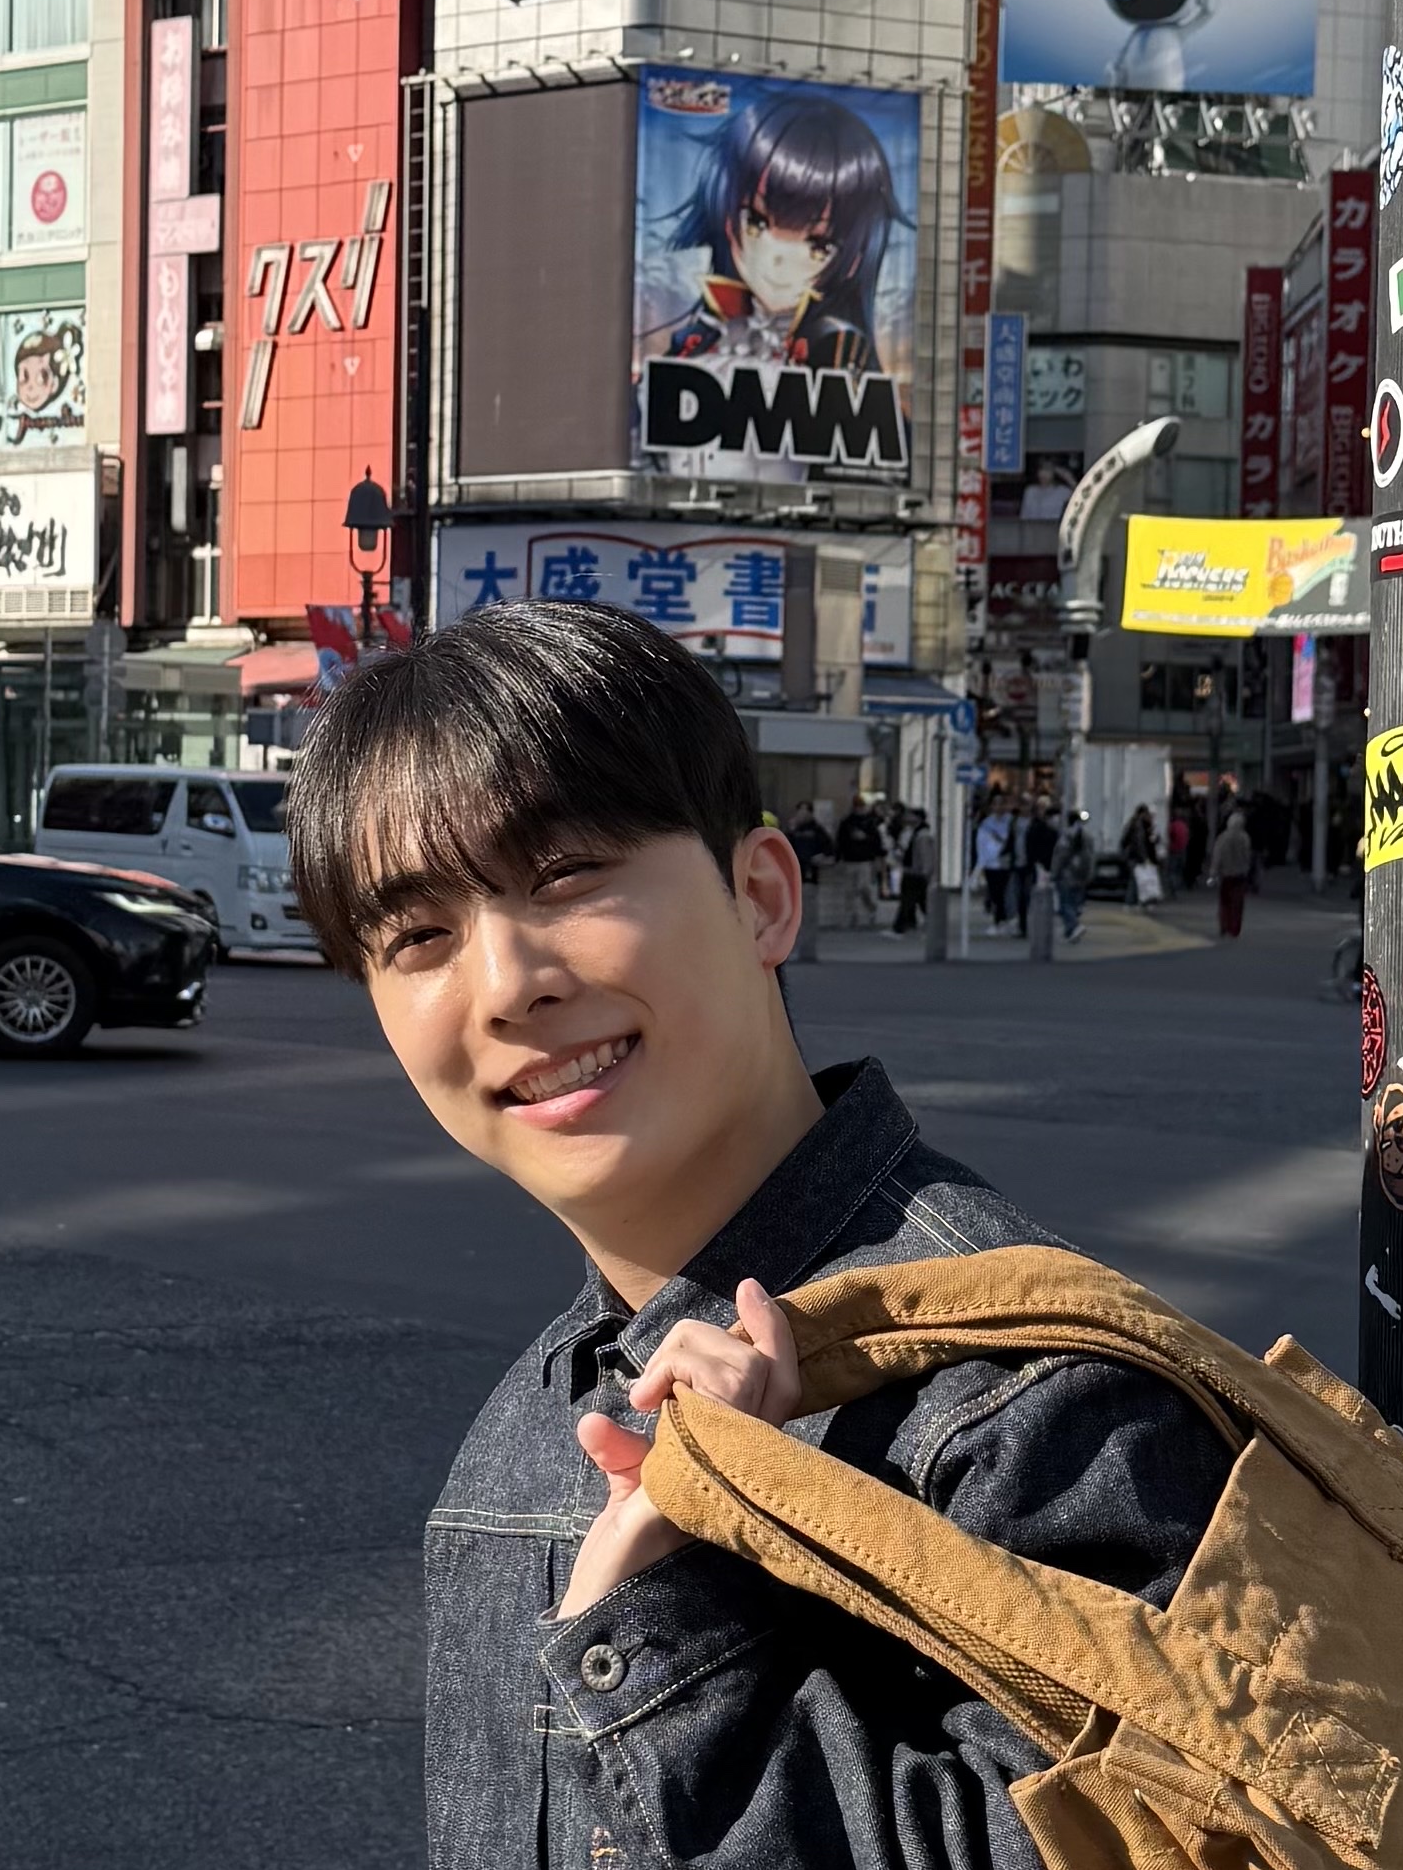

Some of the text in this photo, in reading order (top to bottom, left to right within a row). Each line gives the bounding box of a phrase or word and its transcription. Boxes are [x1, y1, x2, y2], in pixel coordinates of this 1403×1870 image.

[243, 179, 393, 429] クスリ
[1329, 196, 1370, 384] カラオケ
[644, 363, 908, 463] DMM
